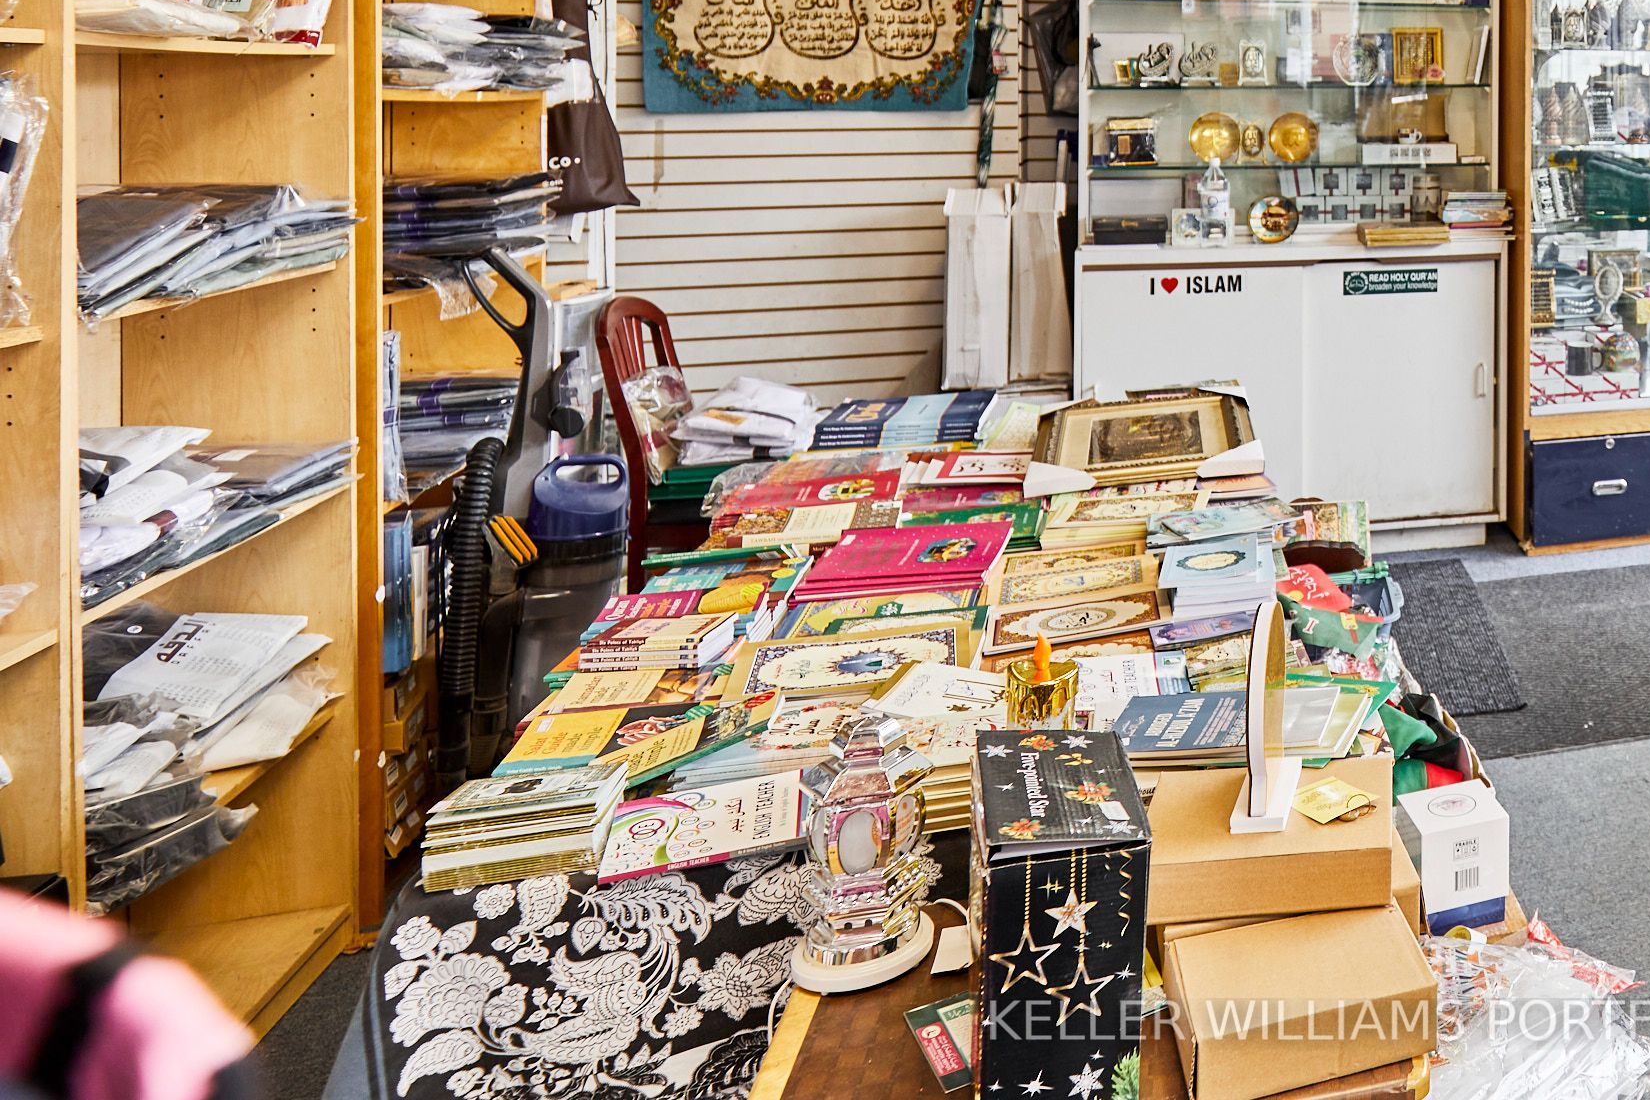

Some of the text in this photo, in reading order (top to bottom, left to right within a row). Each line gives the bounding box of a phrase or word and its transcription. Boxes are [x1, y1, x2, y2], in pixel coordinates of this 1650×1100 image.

[1150, 274, 1242, 295] I ISLAM
[1368, 271, 1438, 282] READ HOLY QUR'AN
[1368, 282, 1392, 291] broaden
[1393, 282, 1406, 291] your
[523, 736, 548, 757] Salat
[541, 731, 569, 756] Guide
[561, 732, 583, 754] made
[578, 726, 604, 752] simple
[754, 779, 776, 812] TEACHER
[1016, 751, 1050, 818] Five-pointed Star
[752, 813, 773, 841] ENGLISH
[1455, 838, 1477, 848] FRAGILE
